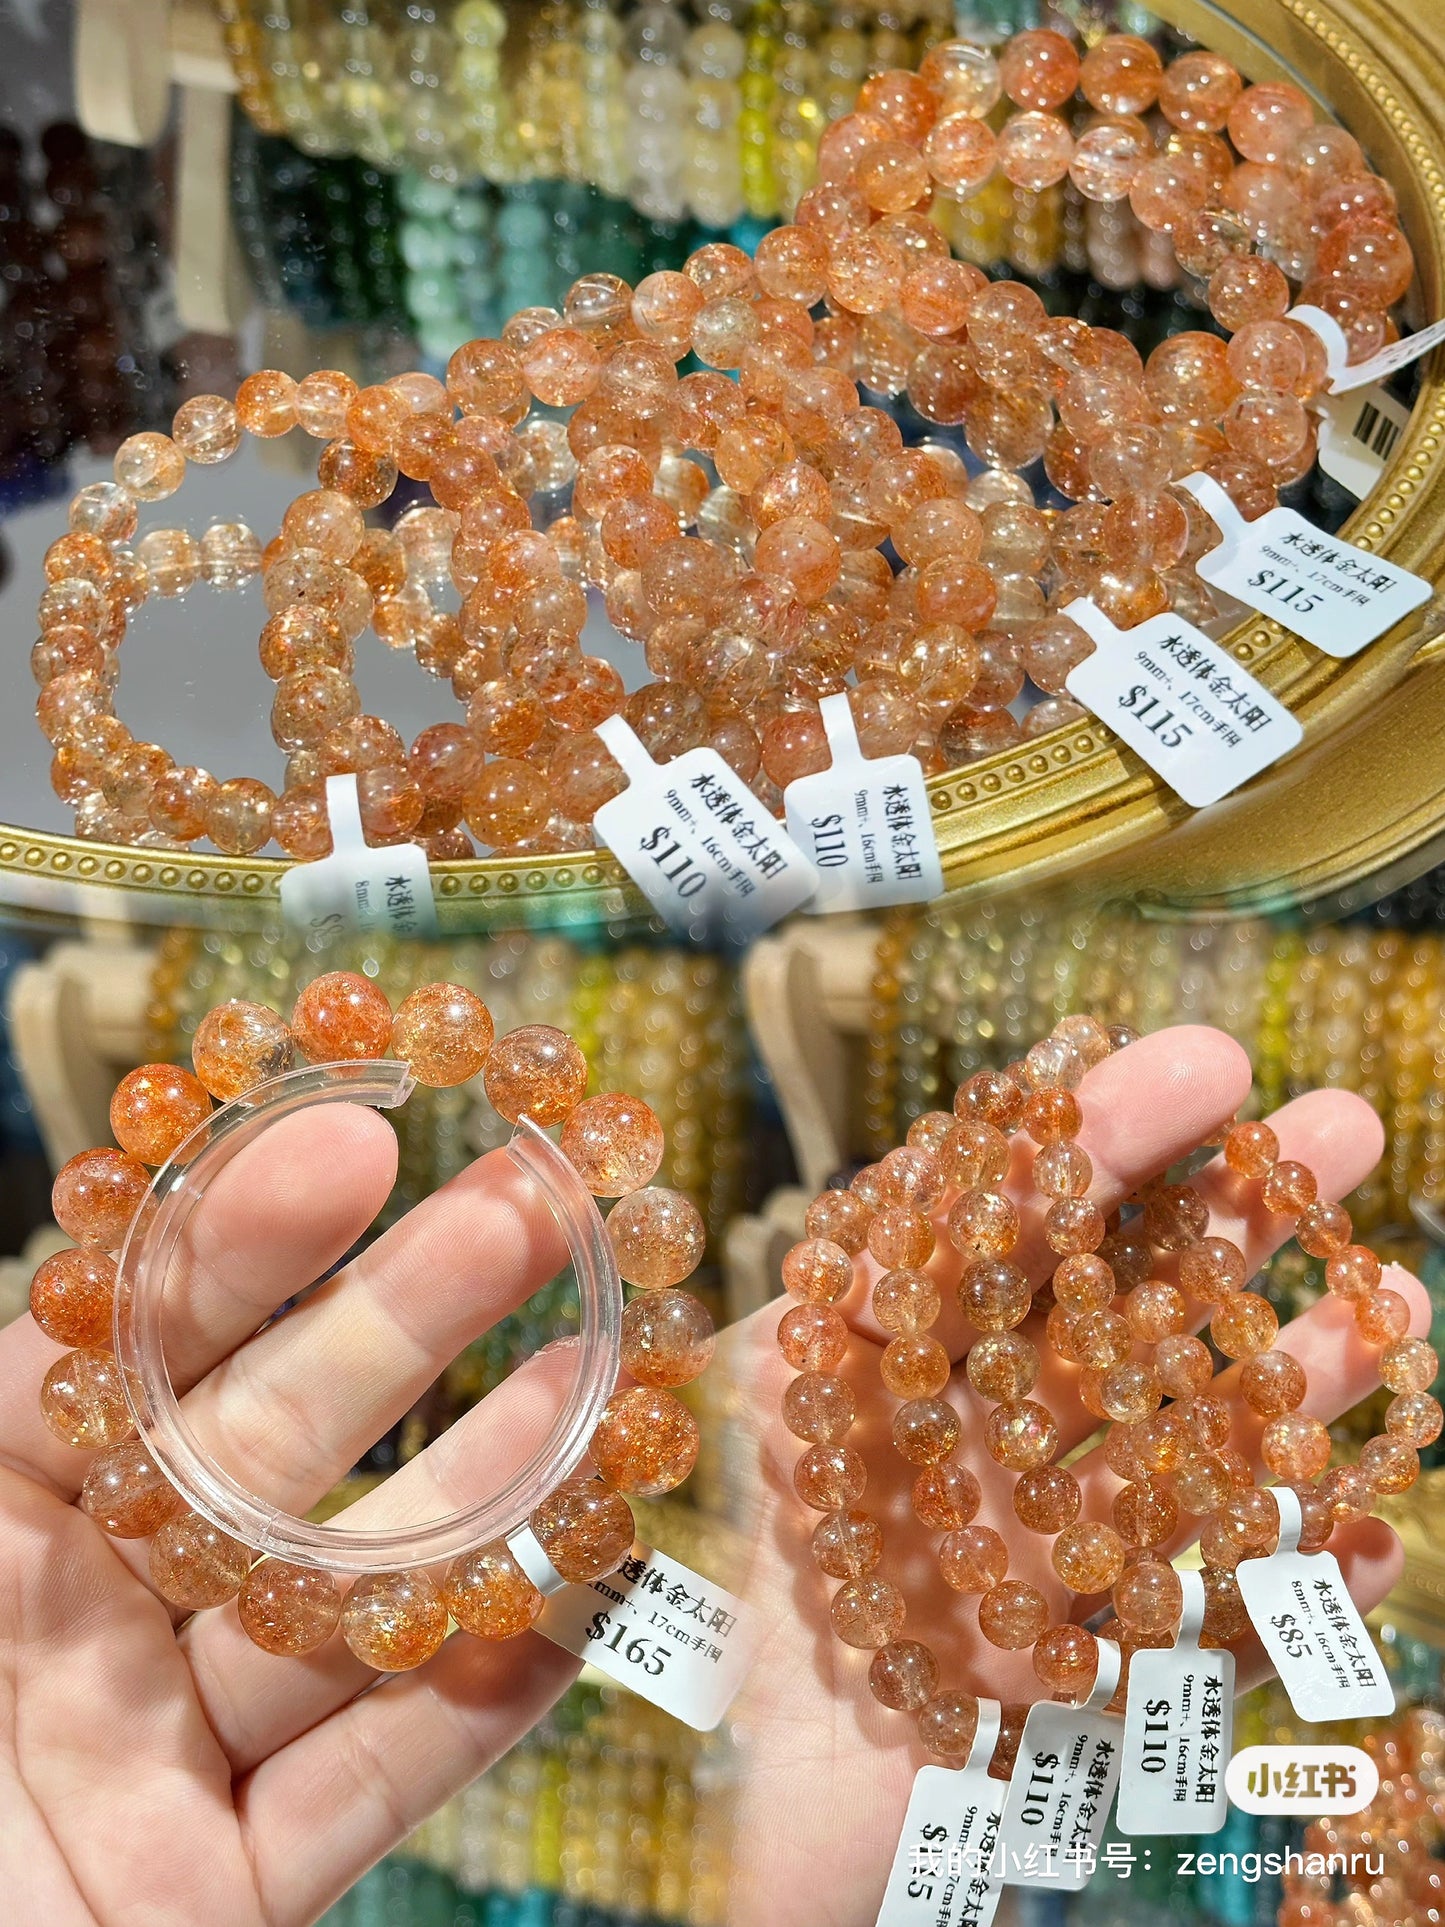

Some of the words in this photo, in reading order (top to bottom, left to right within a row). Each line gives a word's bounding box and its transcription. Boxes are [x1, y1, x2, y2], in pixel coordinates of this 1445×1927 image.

[1247, 568, 1324, 613] $115
[1118, 684, 1194, 748] $115
[639, 825, 707, 898] $110
[808, 814, 848, 867] $110
[617, 1554, 737, 1637] 透体金太阳
[585, 1610, 672, 1676] $165
[1269, 1613, 1313, 1658] $85
[1141, 1698, 1173, 1773] $110
[1021, 1751, 1060, 1826] $110
